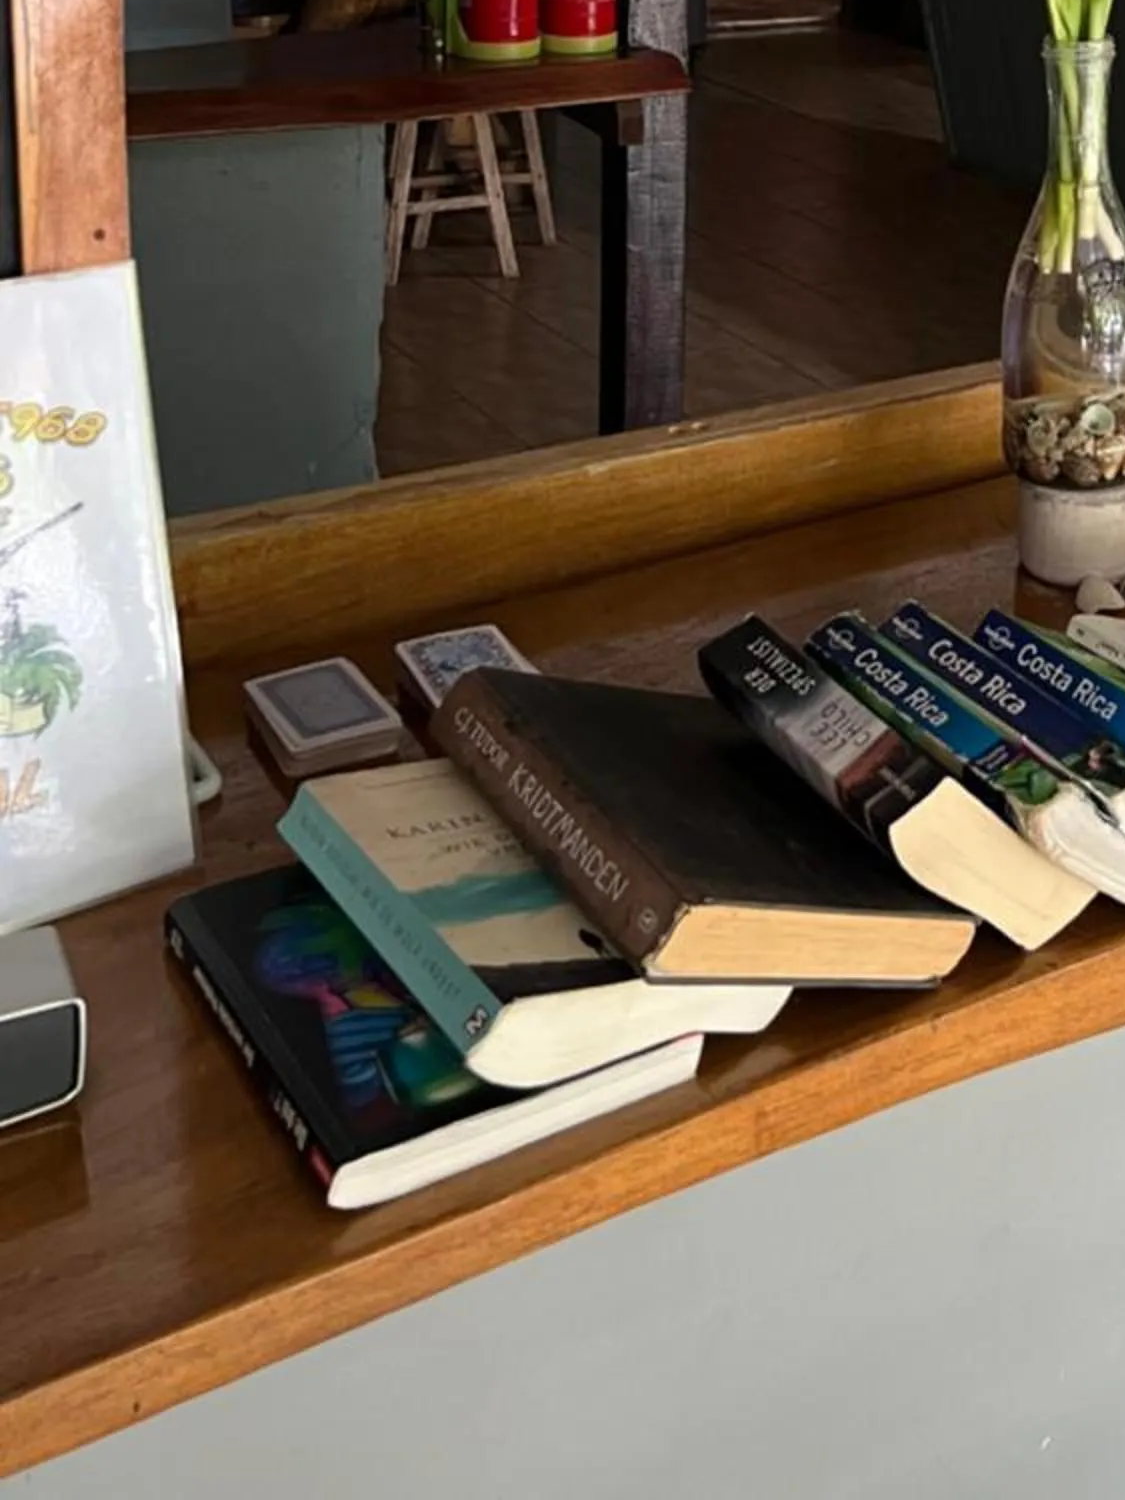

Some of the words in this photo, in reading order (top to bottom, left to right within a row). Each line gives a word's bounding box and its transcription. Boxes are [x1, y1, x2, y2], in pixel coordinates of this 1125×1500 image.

[744, 667, 776, 694] DER
[747, 636, 816, 696] SPEZIALIST
[853, 648, 907, 696] Costa
[903, 688, 949, 727] Rica
[927, 638, 984, 686] Costa
[981, 671, 1028, 717] Rica
[1016, 643, 1075, 692] Costa
[1071, 679, 1119, 721] Rica
[809, 723, 846, 751] LEE
[820, 702, 872, 747] CHILD
[508, 762, 631, 902] KRIDTMANDEN
